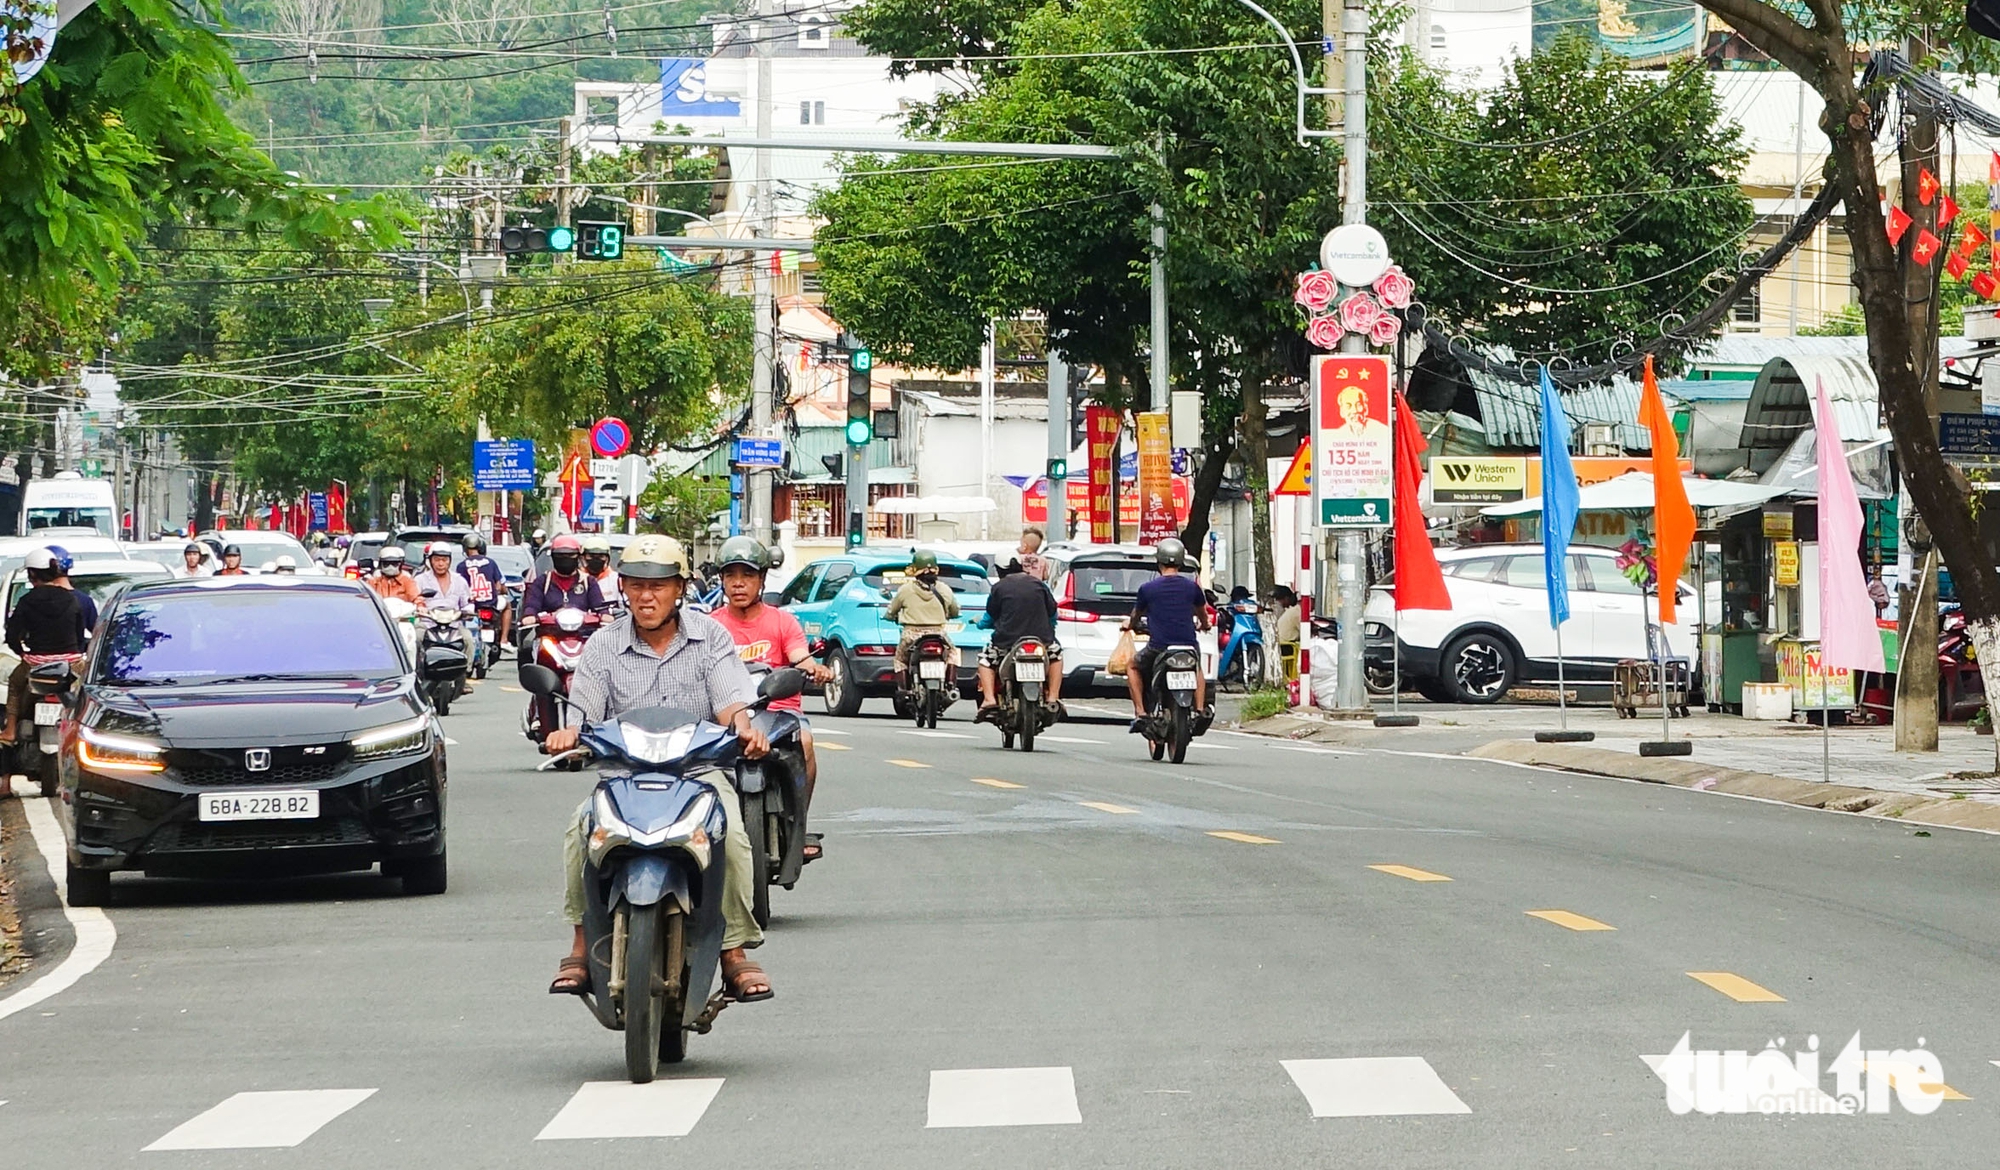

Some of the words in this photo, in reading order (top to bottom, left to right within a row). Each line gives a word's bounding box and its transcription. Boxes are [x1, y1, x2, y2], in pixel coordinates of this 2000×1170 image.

[1331, 251, 1381, 260] Vietcombank
[1328, 449, 1356, 465] 135
[1474, 464, 1516, 474] Western
[1474, 474, 1504, 483] Union
[1330, 513, 1381, 523] Vietcombank
[467, 566, 493, 602] LA
[210, 796, 309, 815] 68A-228.82
